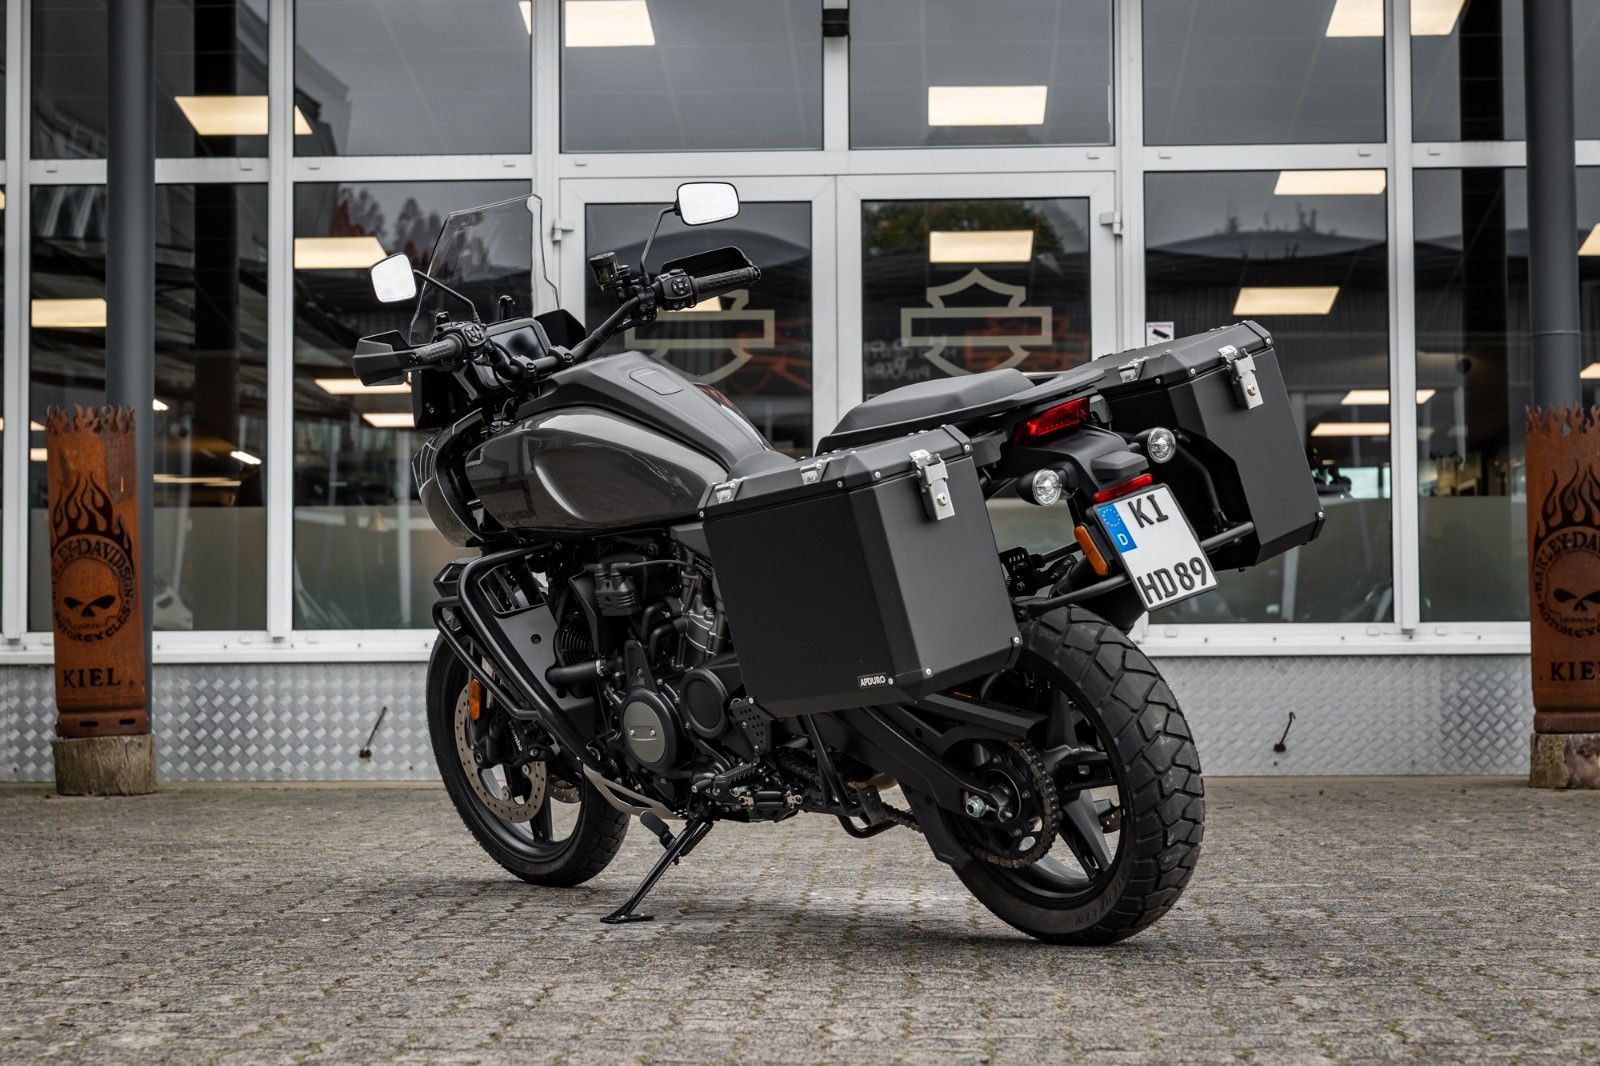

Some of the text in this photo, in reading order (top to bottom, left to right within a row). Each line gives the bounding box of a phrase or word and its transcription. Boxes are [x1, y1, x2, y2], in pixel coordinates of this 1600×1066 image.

[1127, 494, 1169, 528] KI
[1117, 533, 1129, 546] D
[52, 538, 134, 600] LEY-DAVIDSON
[1534, 531, 1600, 592] HARLEY-DA
[1136, 556, 1207, 604] HD89
[62, 667, 122, 689] KIEL
[1550, 661, 1600, 681] KIE
